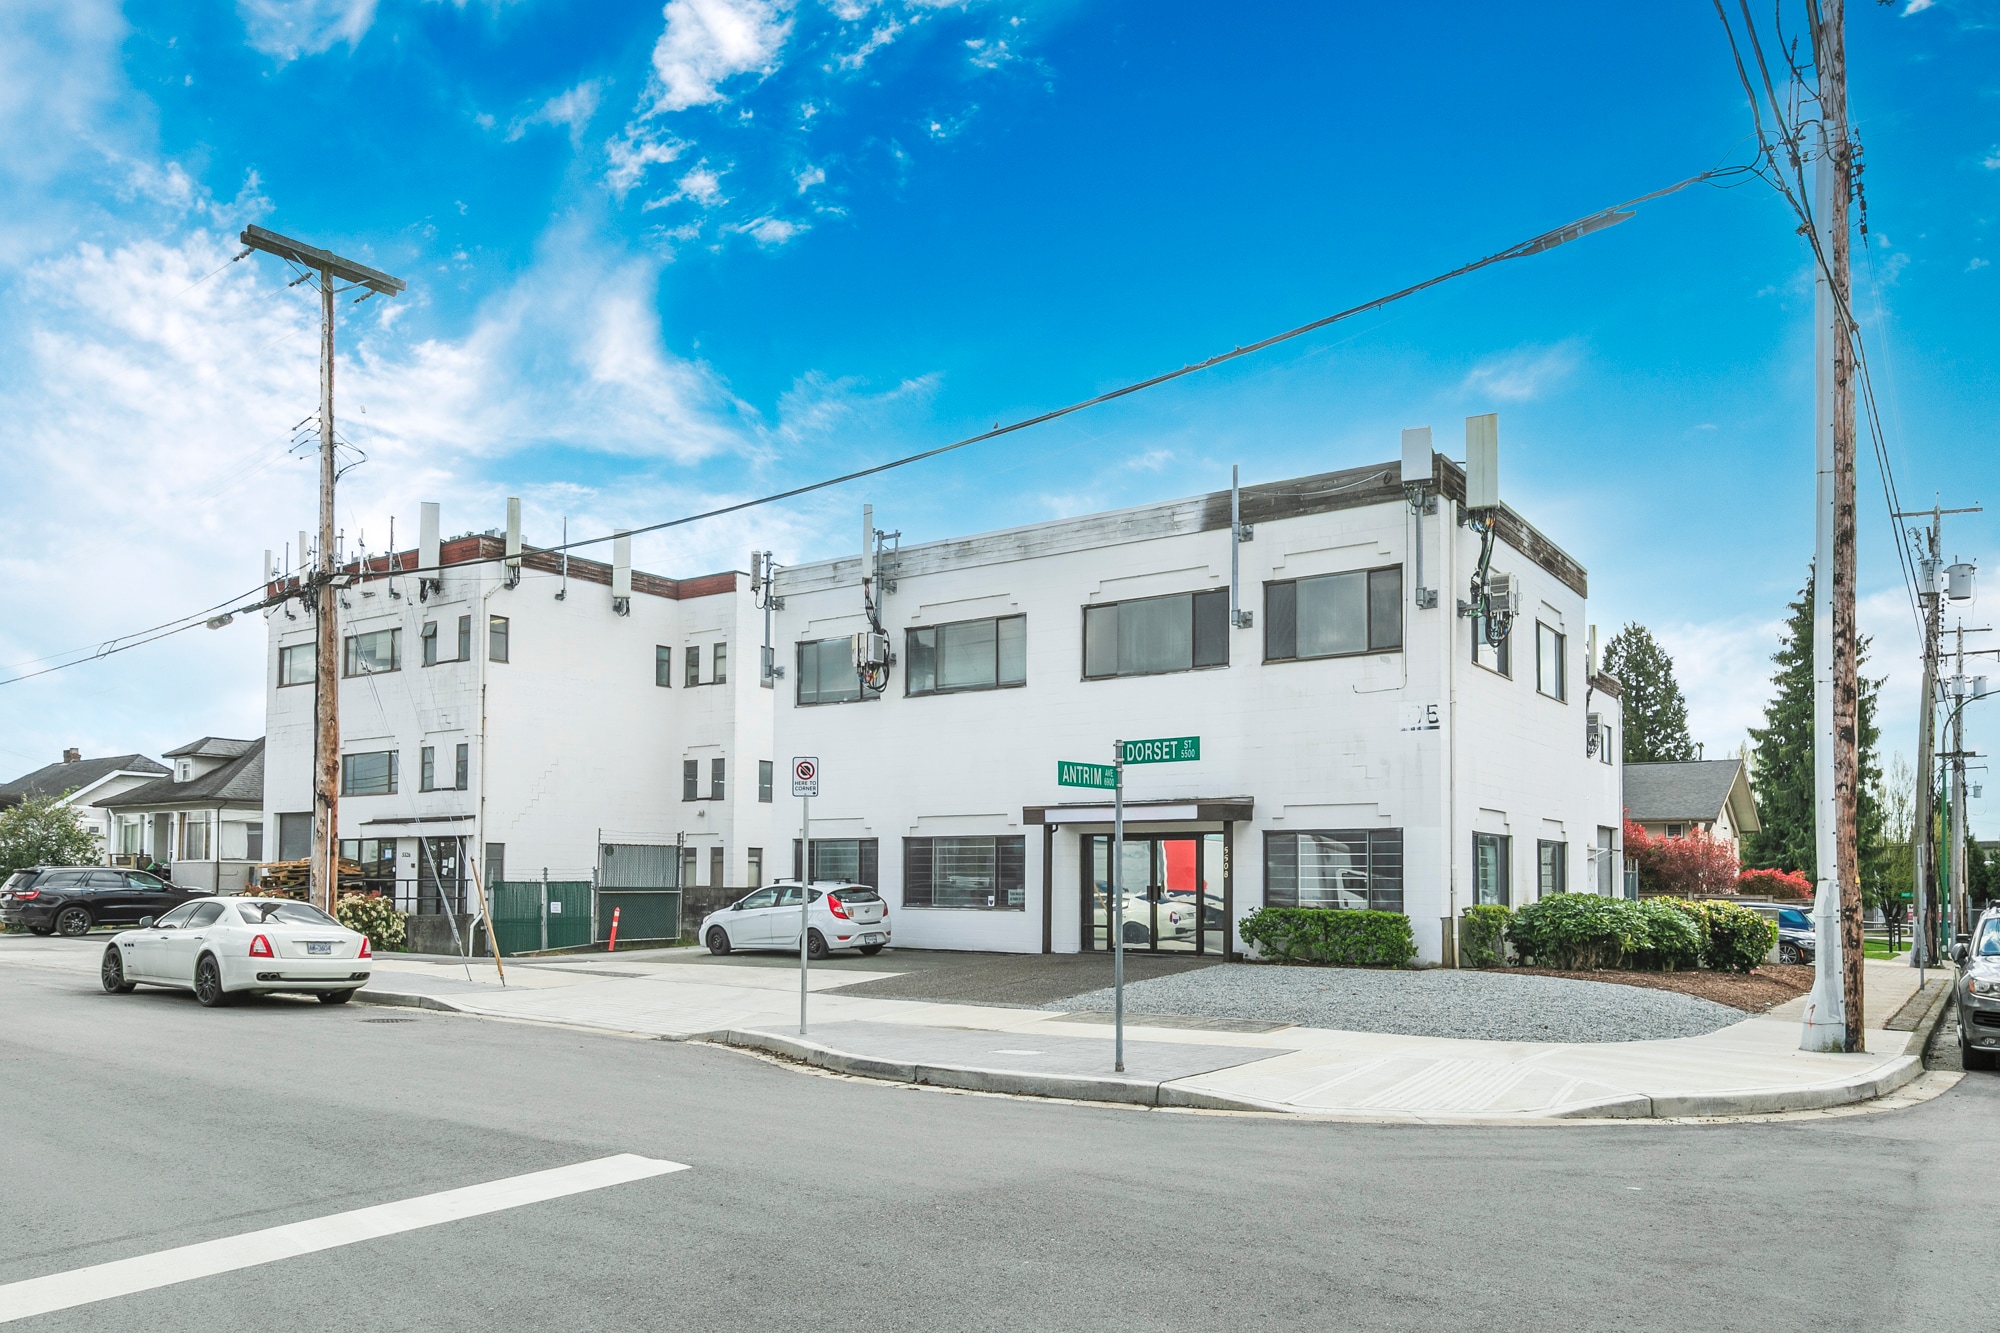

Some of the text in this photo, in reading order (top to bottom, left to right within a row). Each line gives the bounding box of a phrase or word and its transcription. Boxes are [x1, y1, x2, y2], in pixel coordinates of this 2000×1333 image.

[1126, 740, 1192, 761] DORSET ST
[1181, 749, 1195, 758] 5500
[1062, 764, 1114, 785] ANTRIM AVE
